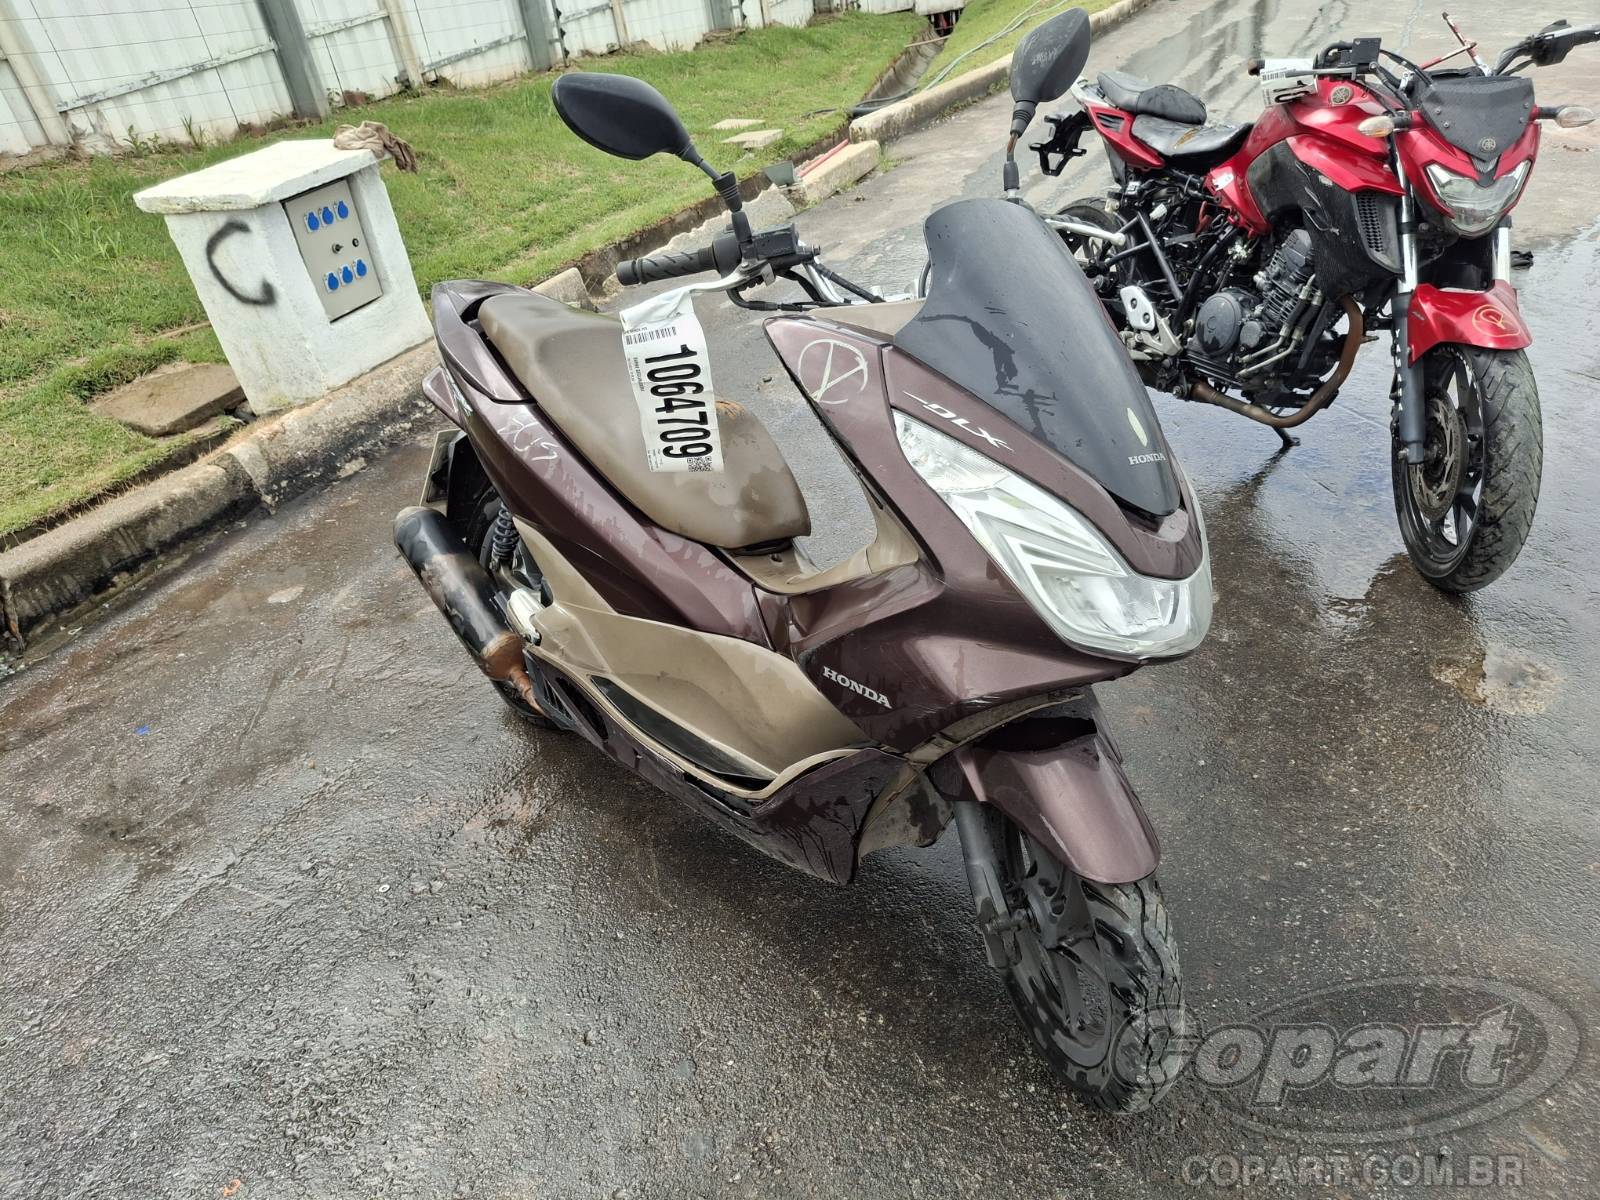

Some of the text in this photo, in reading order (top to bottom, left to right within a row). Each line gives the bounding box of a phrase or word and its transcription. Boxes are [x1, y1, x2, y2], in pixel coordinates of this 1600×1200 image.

[206, 221, 277, 306] C
[645, 344, 713, 458] 1064709
[902, 390, 1014, 453] DLX
[1128, 453, 1166, 465] HONDA
[823, 666, 892, 709] HONDA
